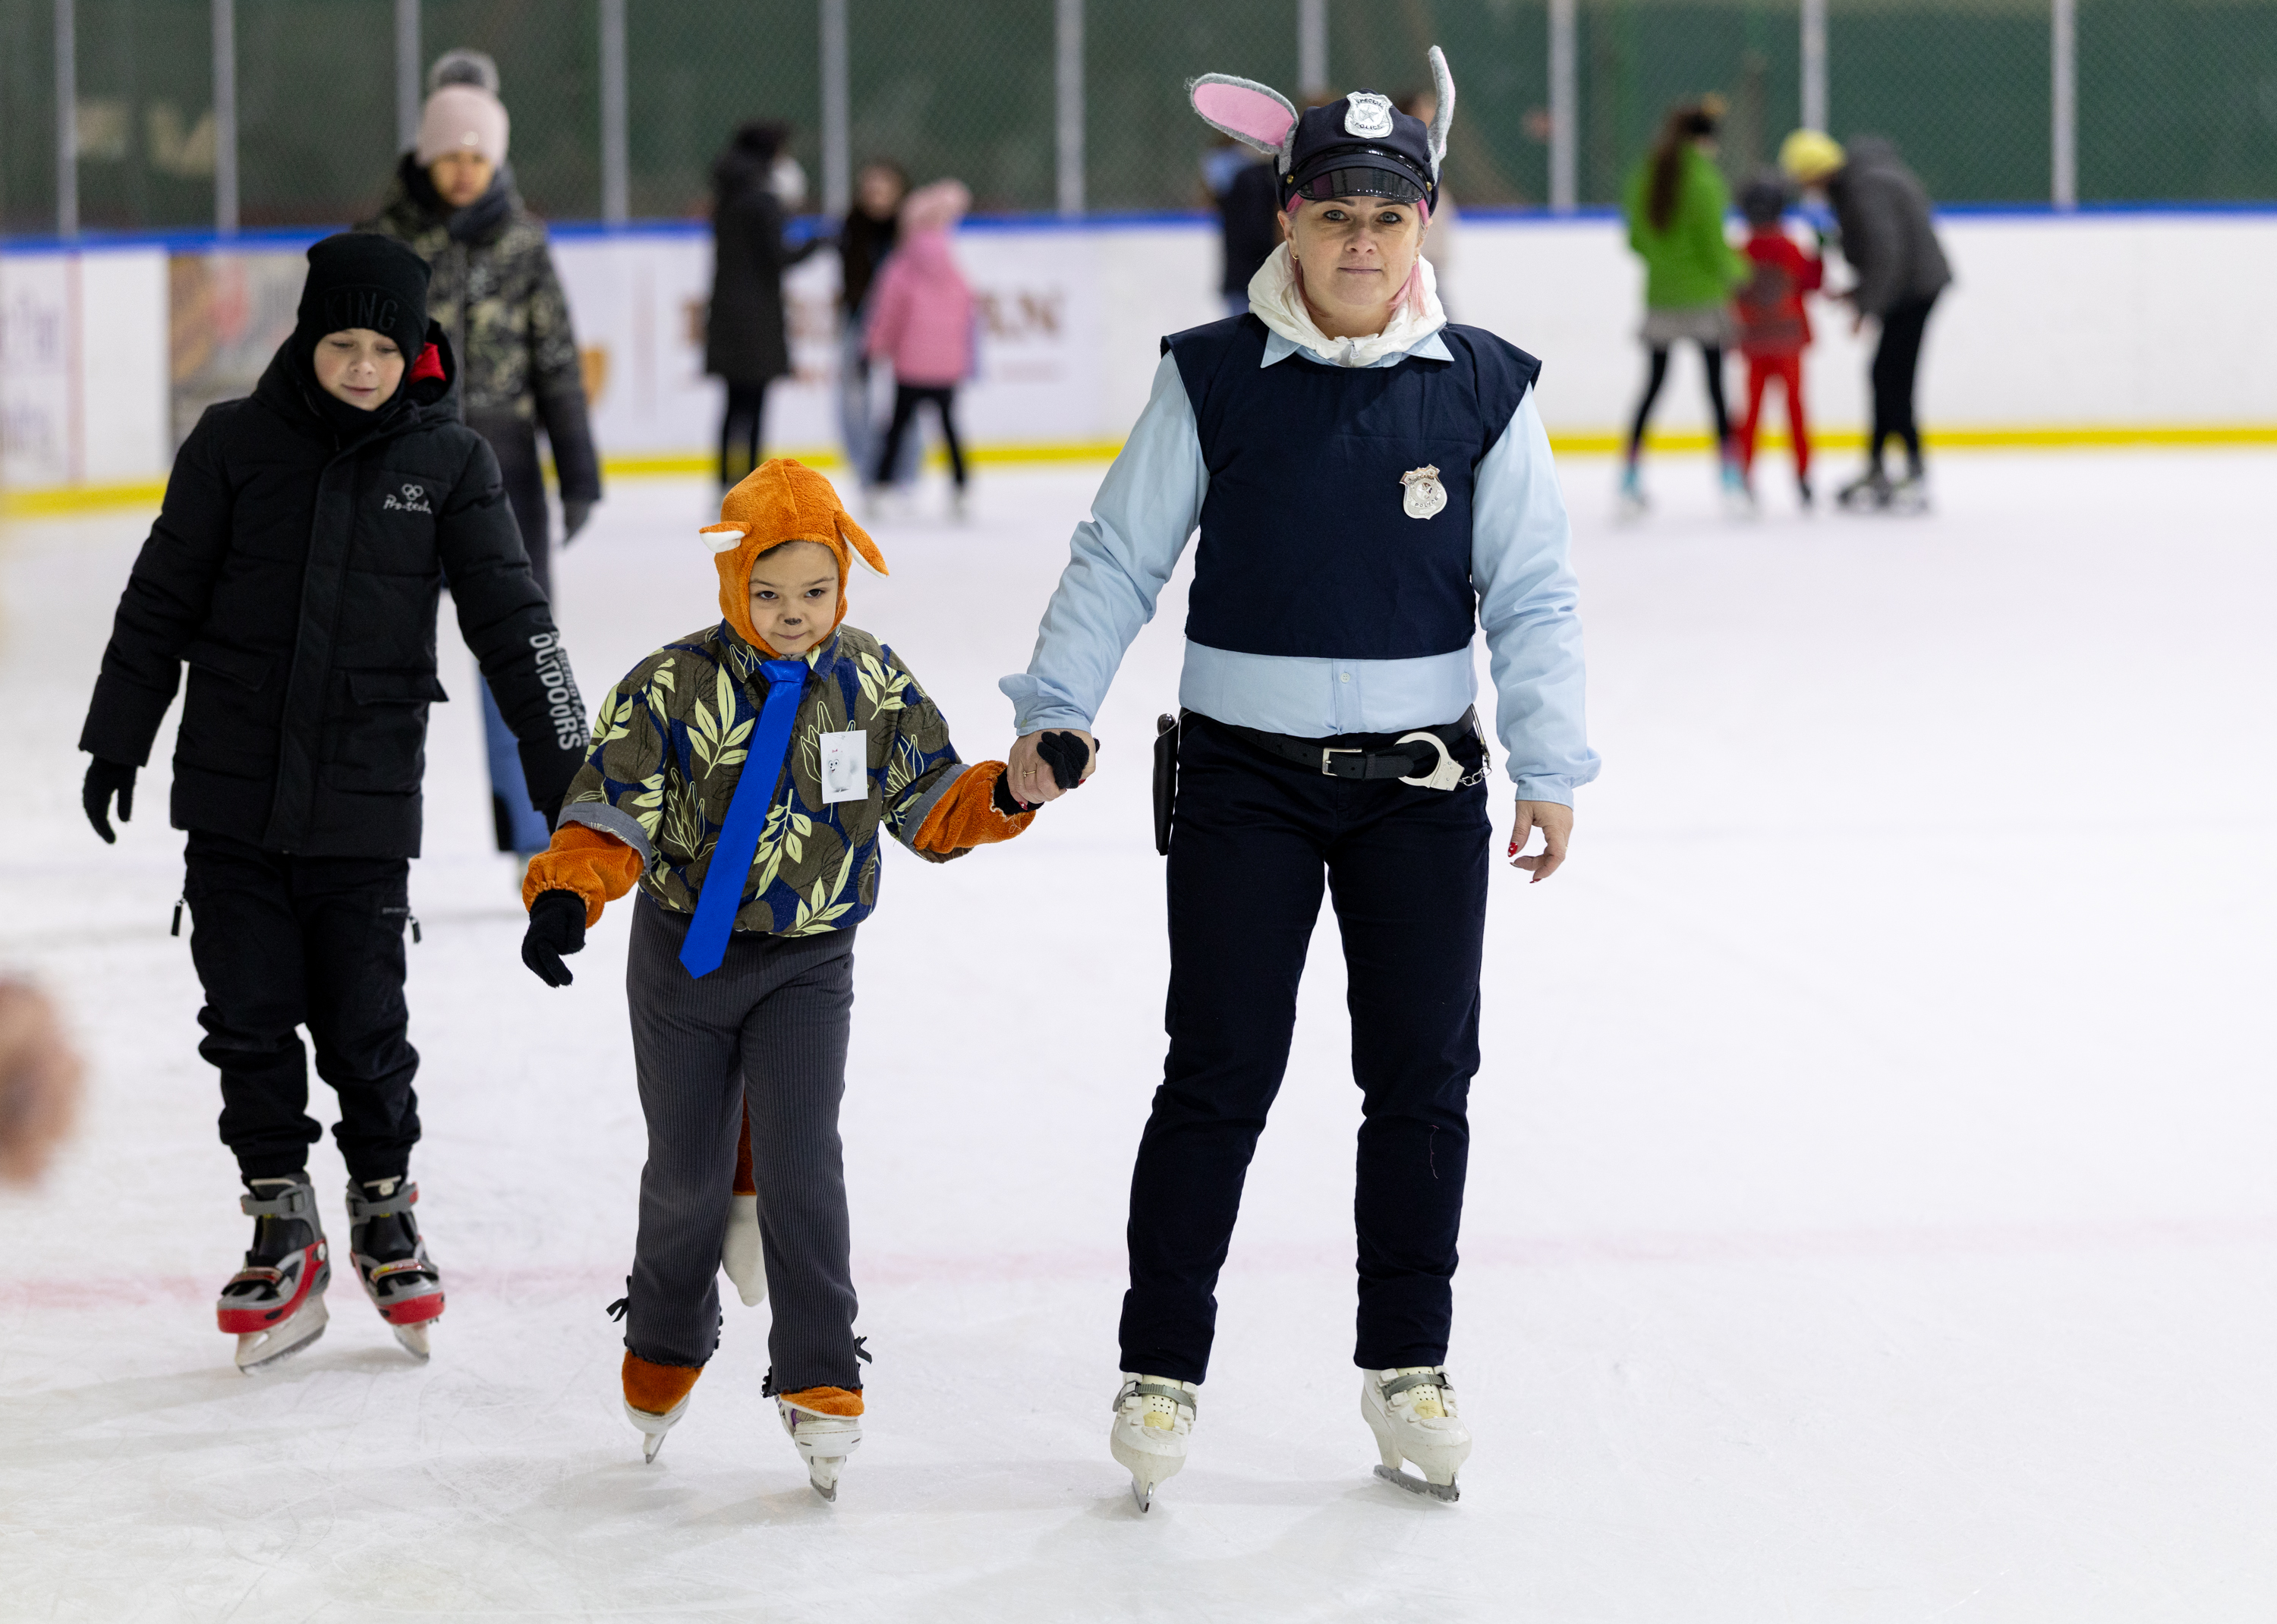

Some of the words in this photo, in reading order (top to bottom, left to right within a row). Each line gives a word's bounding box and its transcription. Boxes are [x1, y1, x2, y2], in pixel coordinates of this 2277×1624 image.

[324, 291, 398, 332] KING
[1415, 496, 1439, 508] POLICE
[529, 632, 582, 751] OUTDOORS
